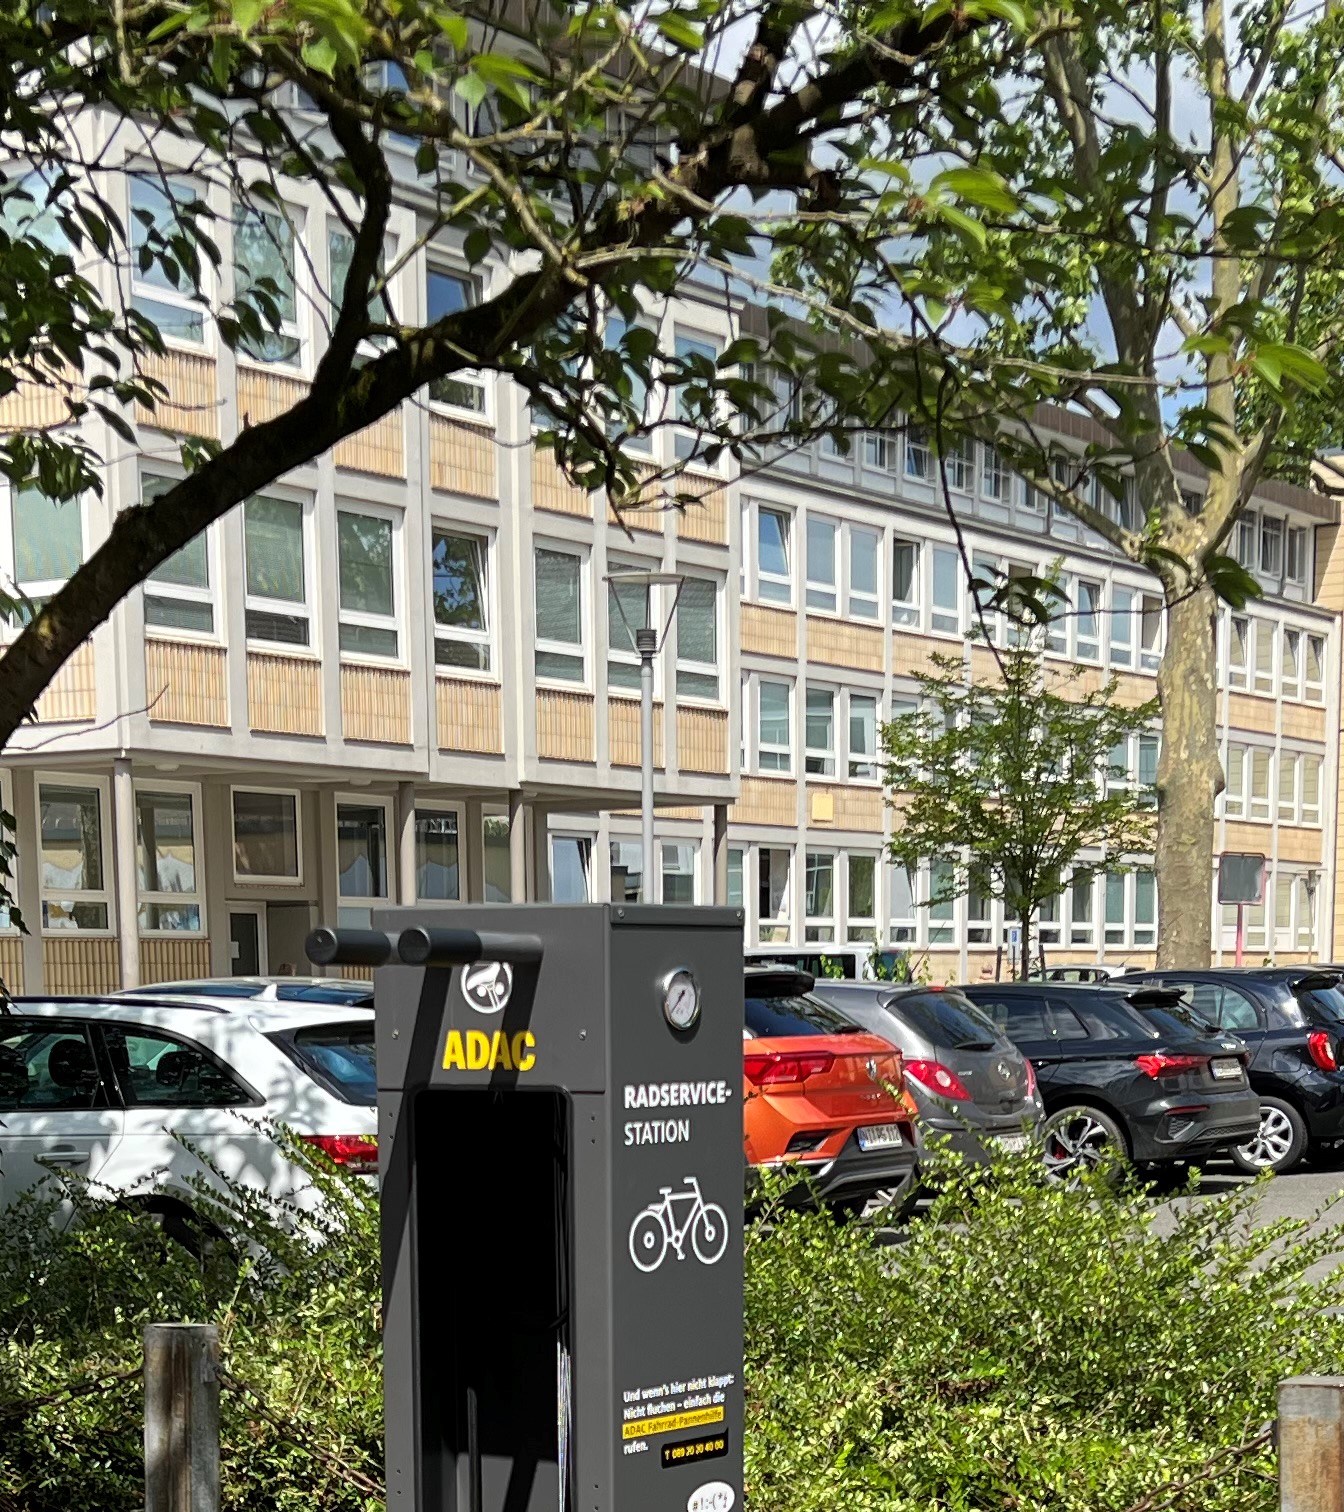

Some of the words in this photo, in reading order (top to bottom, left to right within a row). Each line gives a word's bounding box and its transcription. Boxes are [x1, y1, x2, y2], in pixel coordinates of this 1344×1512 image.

[442, 1030, 536, 1071] ADAC
[624, 1080, 732, 1109] RADSERVICE-
[624, 1119, 690, 1146] STATION
[623, 1388, 641, 1403] Und
[670, 1381, 687, 1395] hier
[687, 1378, 707, 1392] nicht
[623, 1405, 646, 1420] Nicht
[683, 1393, 712, 1409] einfach
[712, 1390, 726, 1403] die
[624, 1425, 646, 1436] ADAC
